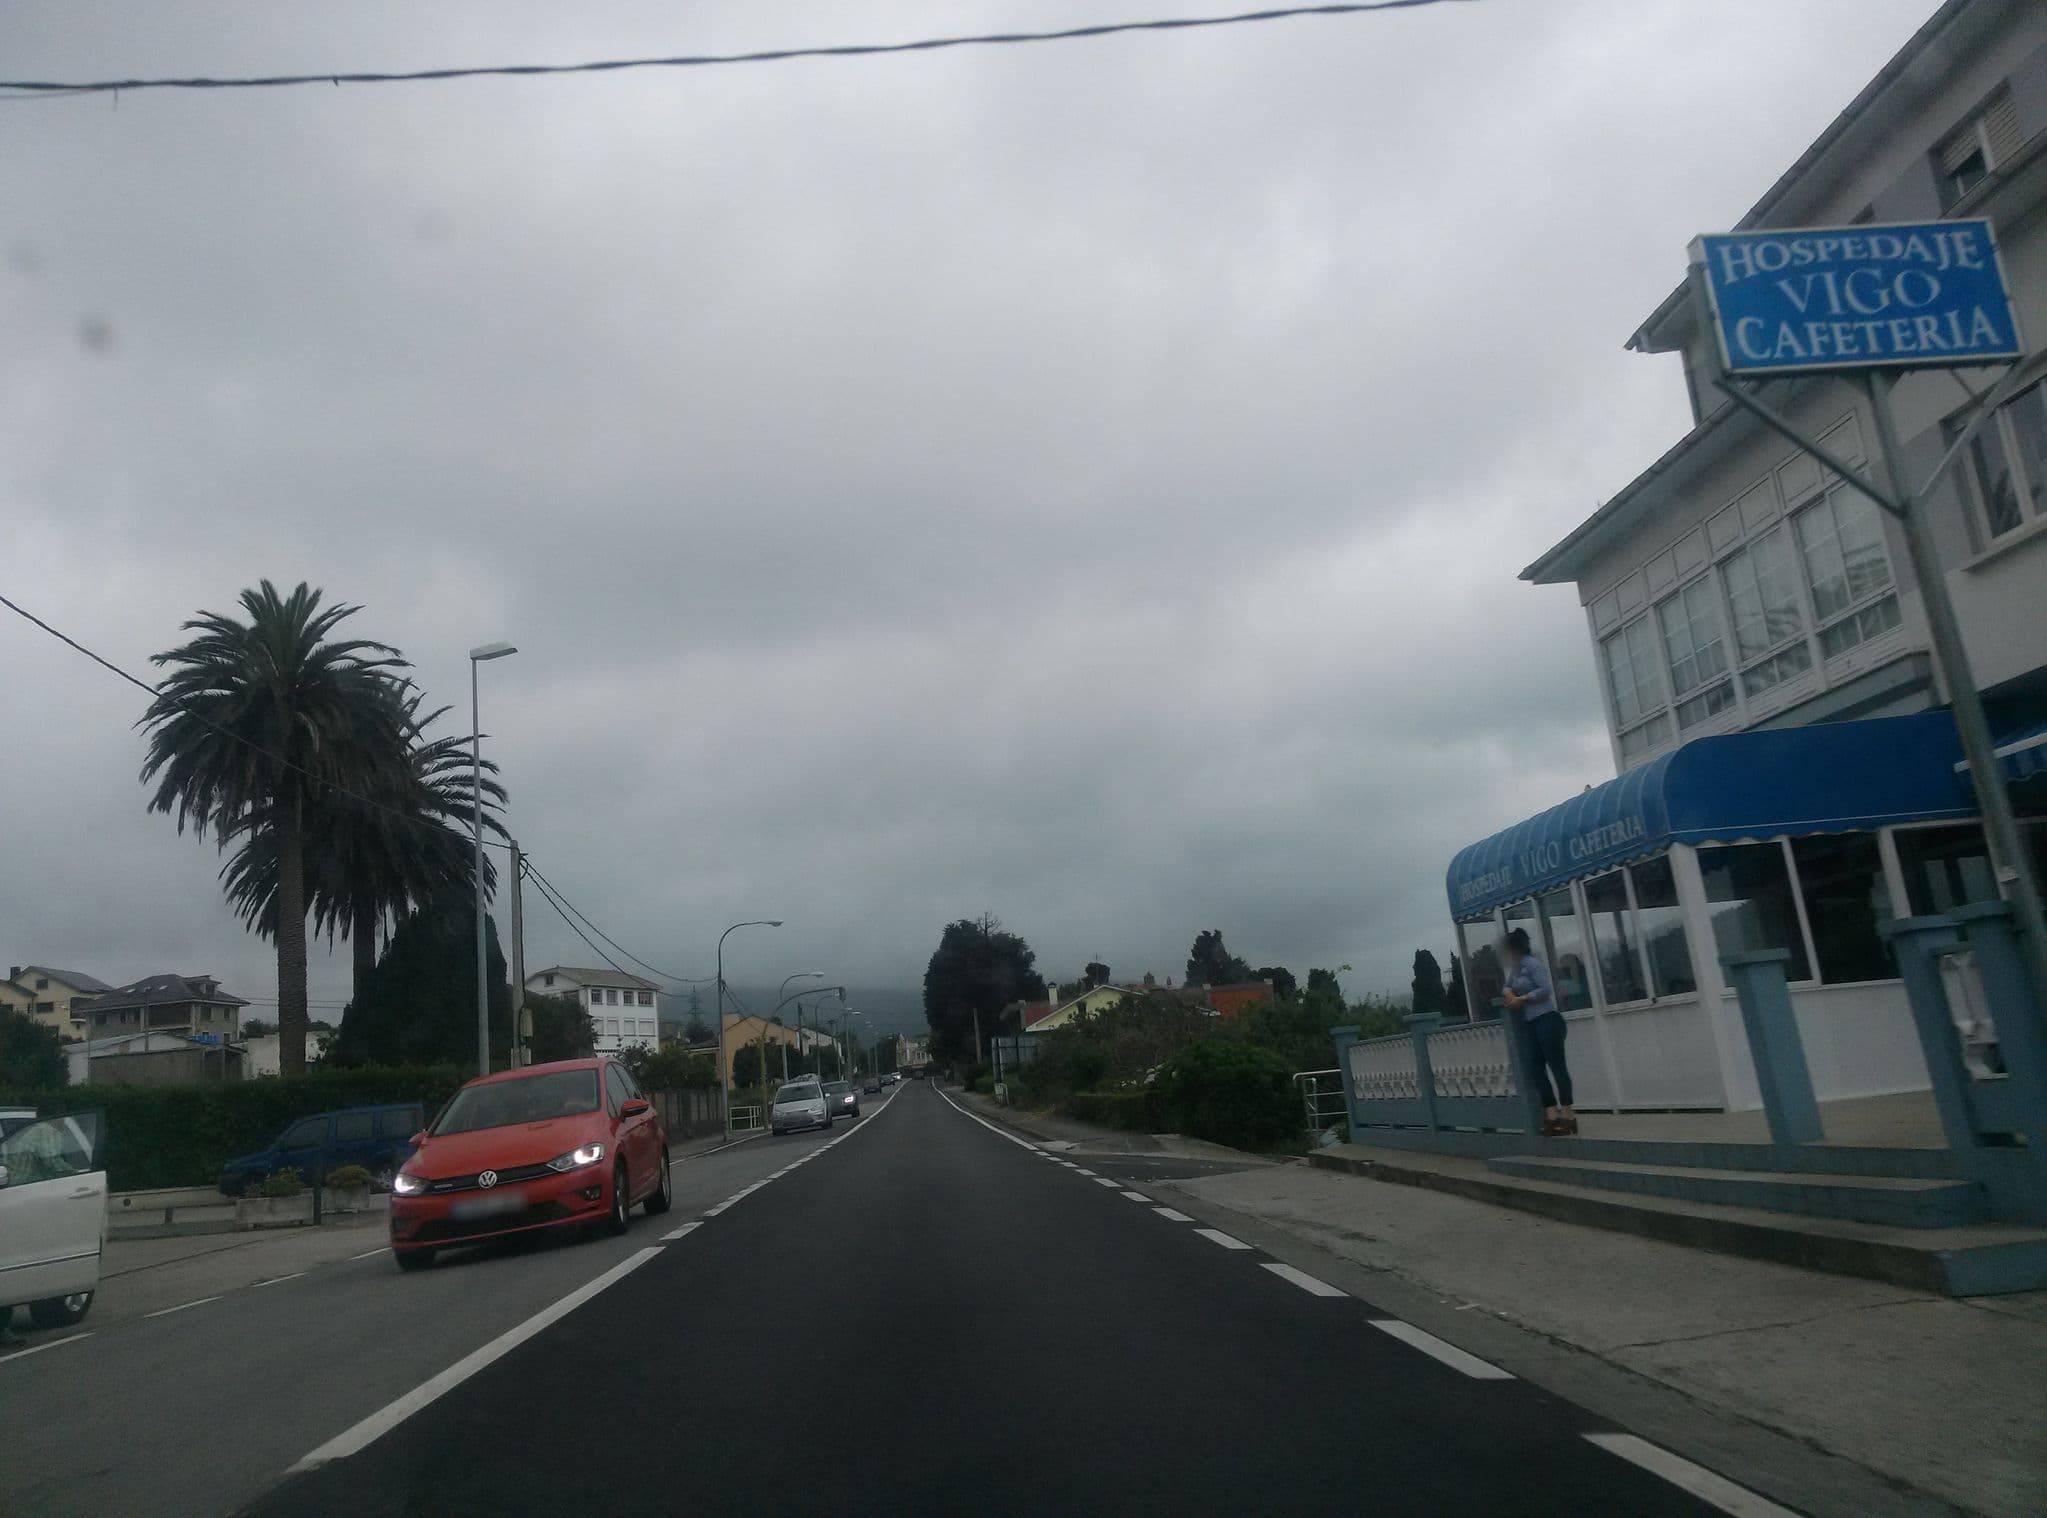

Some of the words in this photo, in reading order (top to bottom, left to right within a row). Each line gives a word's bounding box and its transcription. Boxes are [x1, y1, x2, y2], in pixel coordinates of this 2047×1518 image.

[1719, 231, 1984, 285] HOSPEDAJE
[1776, 268, 1941, 315] VIGO
[1737, 306, 2001, 360] CAFETERIA
[1570, 816, 1646, 859] CAFETERIA
